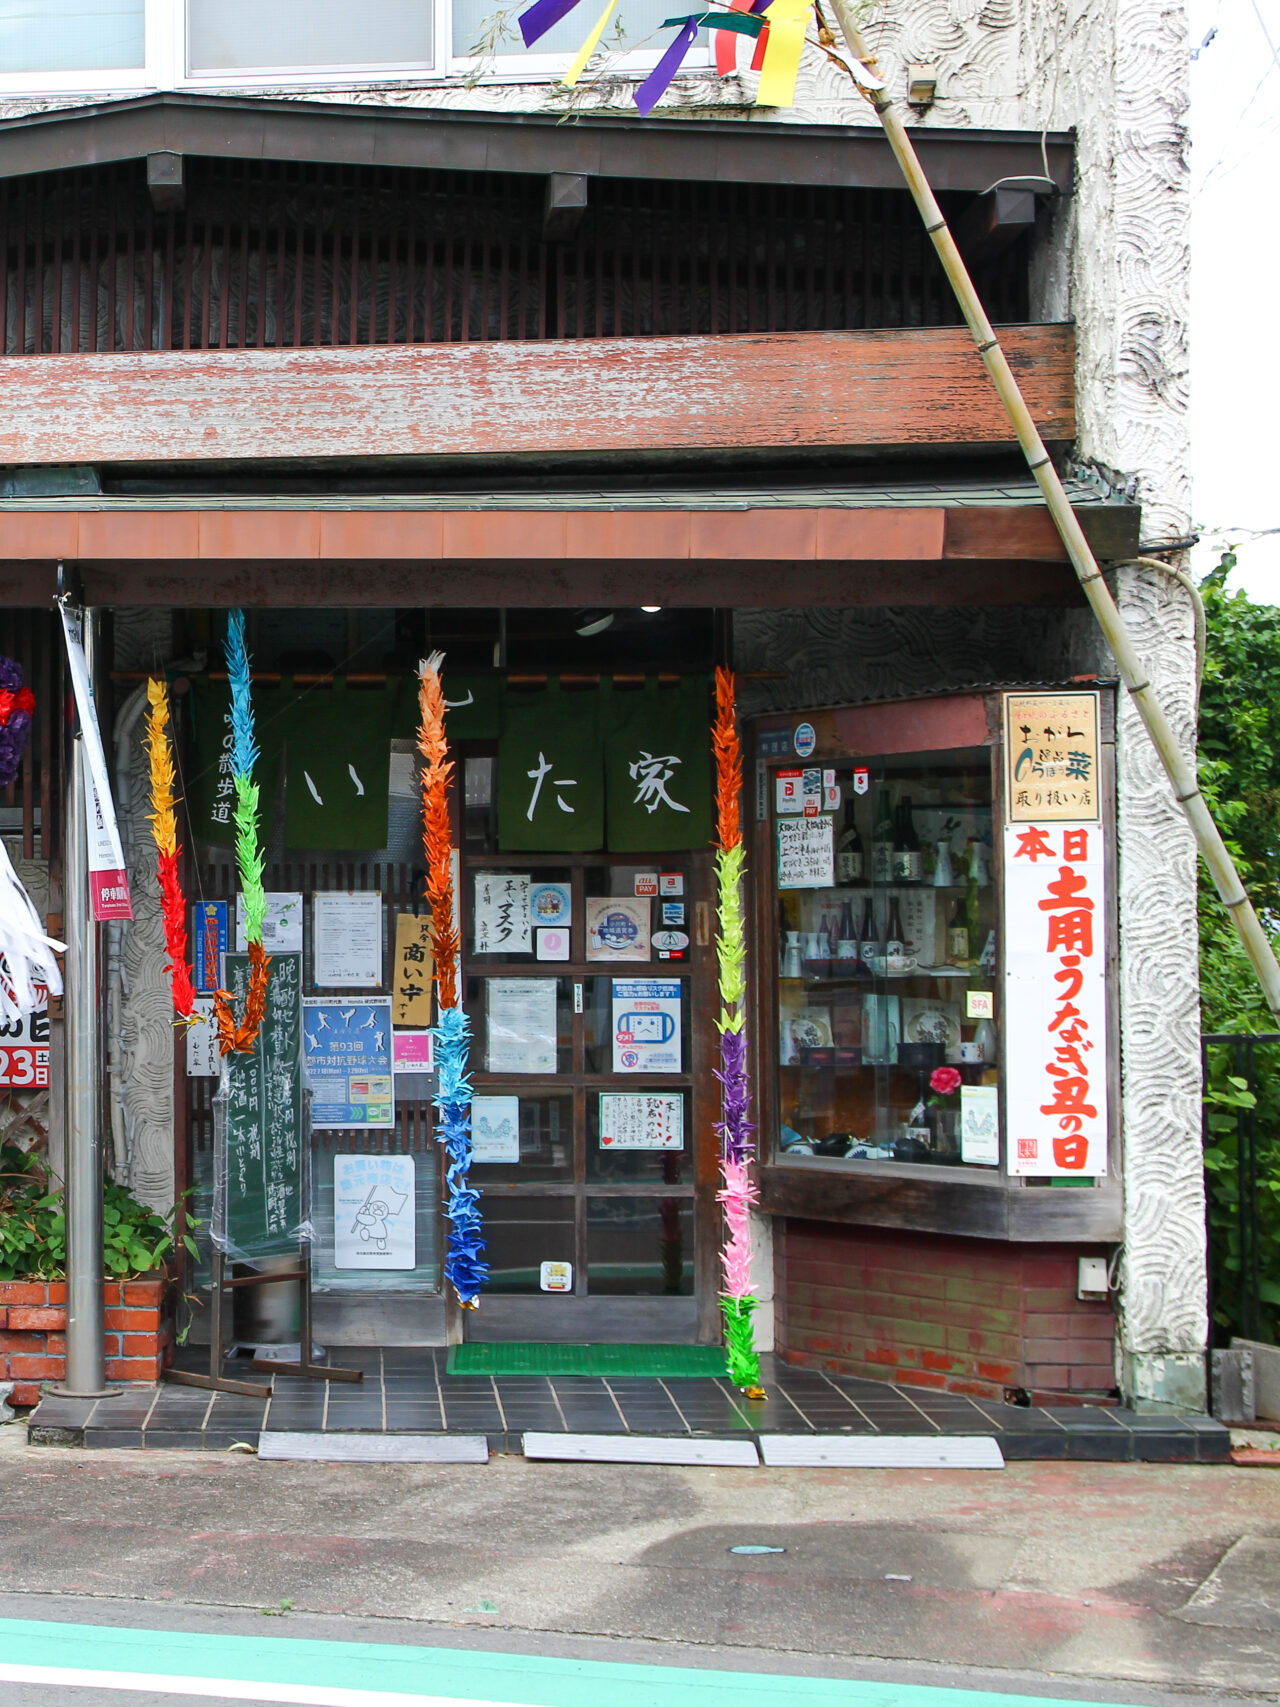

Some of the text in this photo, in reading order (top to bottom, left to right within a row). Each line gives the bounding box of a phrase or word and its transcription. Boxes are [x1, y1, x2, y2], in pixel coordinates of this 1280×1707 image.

[1016, 789, 1092, 807] 取り扱い店
[1013, 825, 1090, 863] 本日
[400, 943, 427, 1002] 商い中
[971, 1000, 988, 1009] SFA
[1038, 865, 1098, 1171] 土用うなぎ丑の日
[329, 1041, 364, 1052] 第93回
